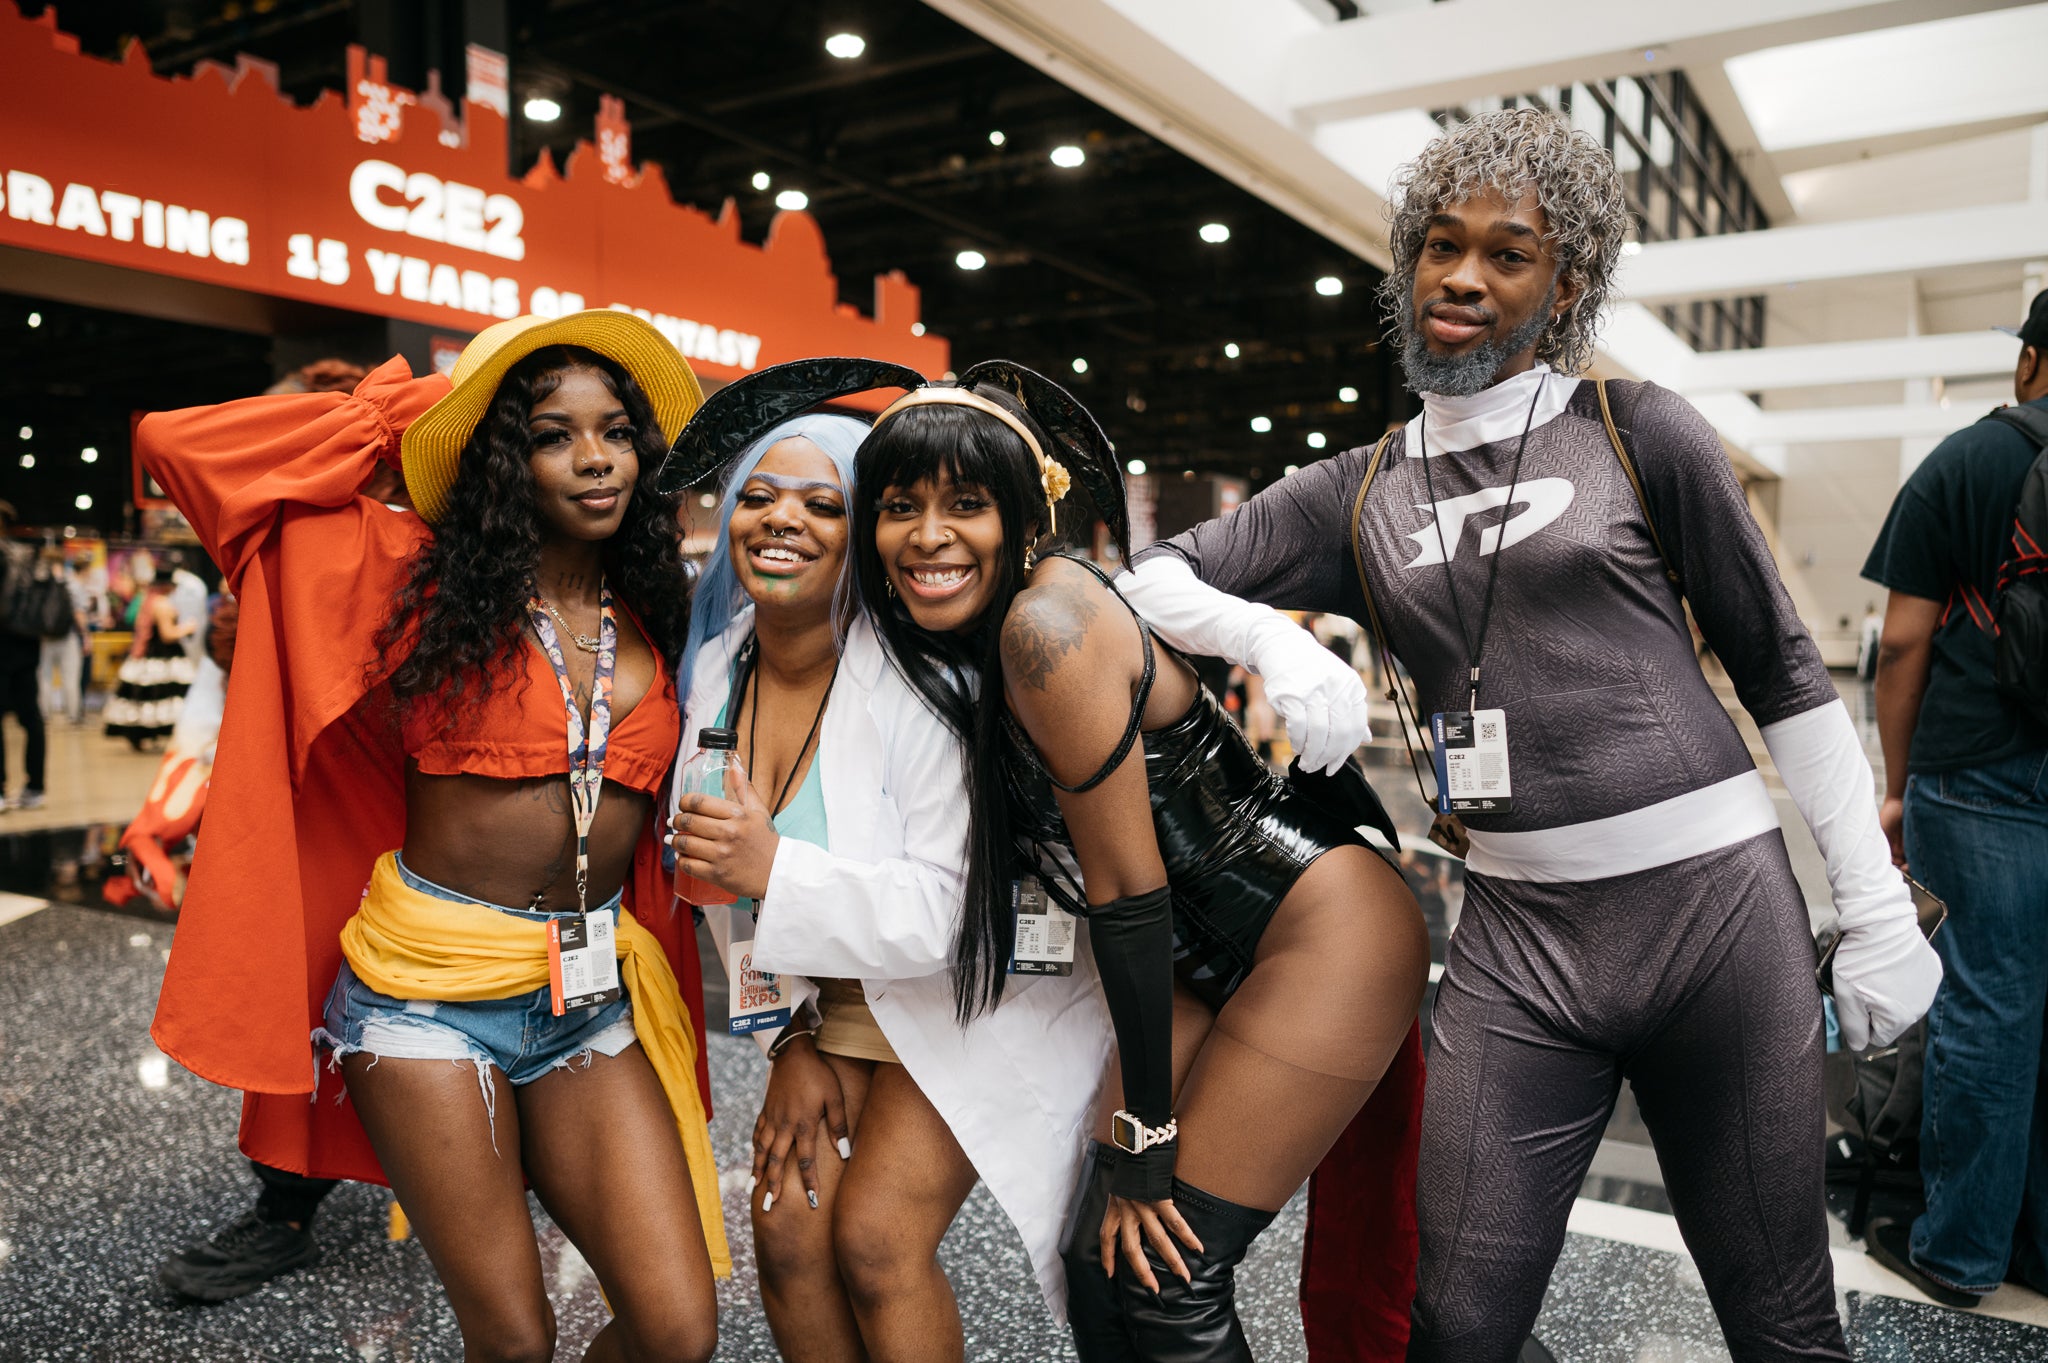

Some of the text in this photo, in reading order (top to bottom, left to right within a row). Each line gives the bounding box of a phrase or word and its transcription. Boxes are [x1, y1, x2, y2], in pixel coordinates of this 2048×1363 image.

[0, 168, 250, 266] RATING
[349, 159, 526, 262] C2E2
[286, 233, 351, 286] 15
[364, 248, 521, 320] YEARS
[607, 303, 761, 370] NTASY
[740, 991, 781, 1009] EXPO
